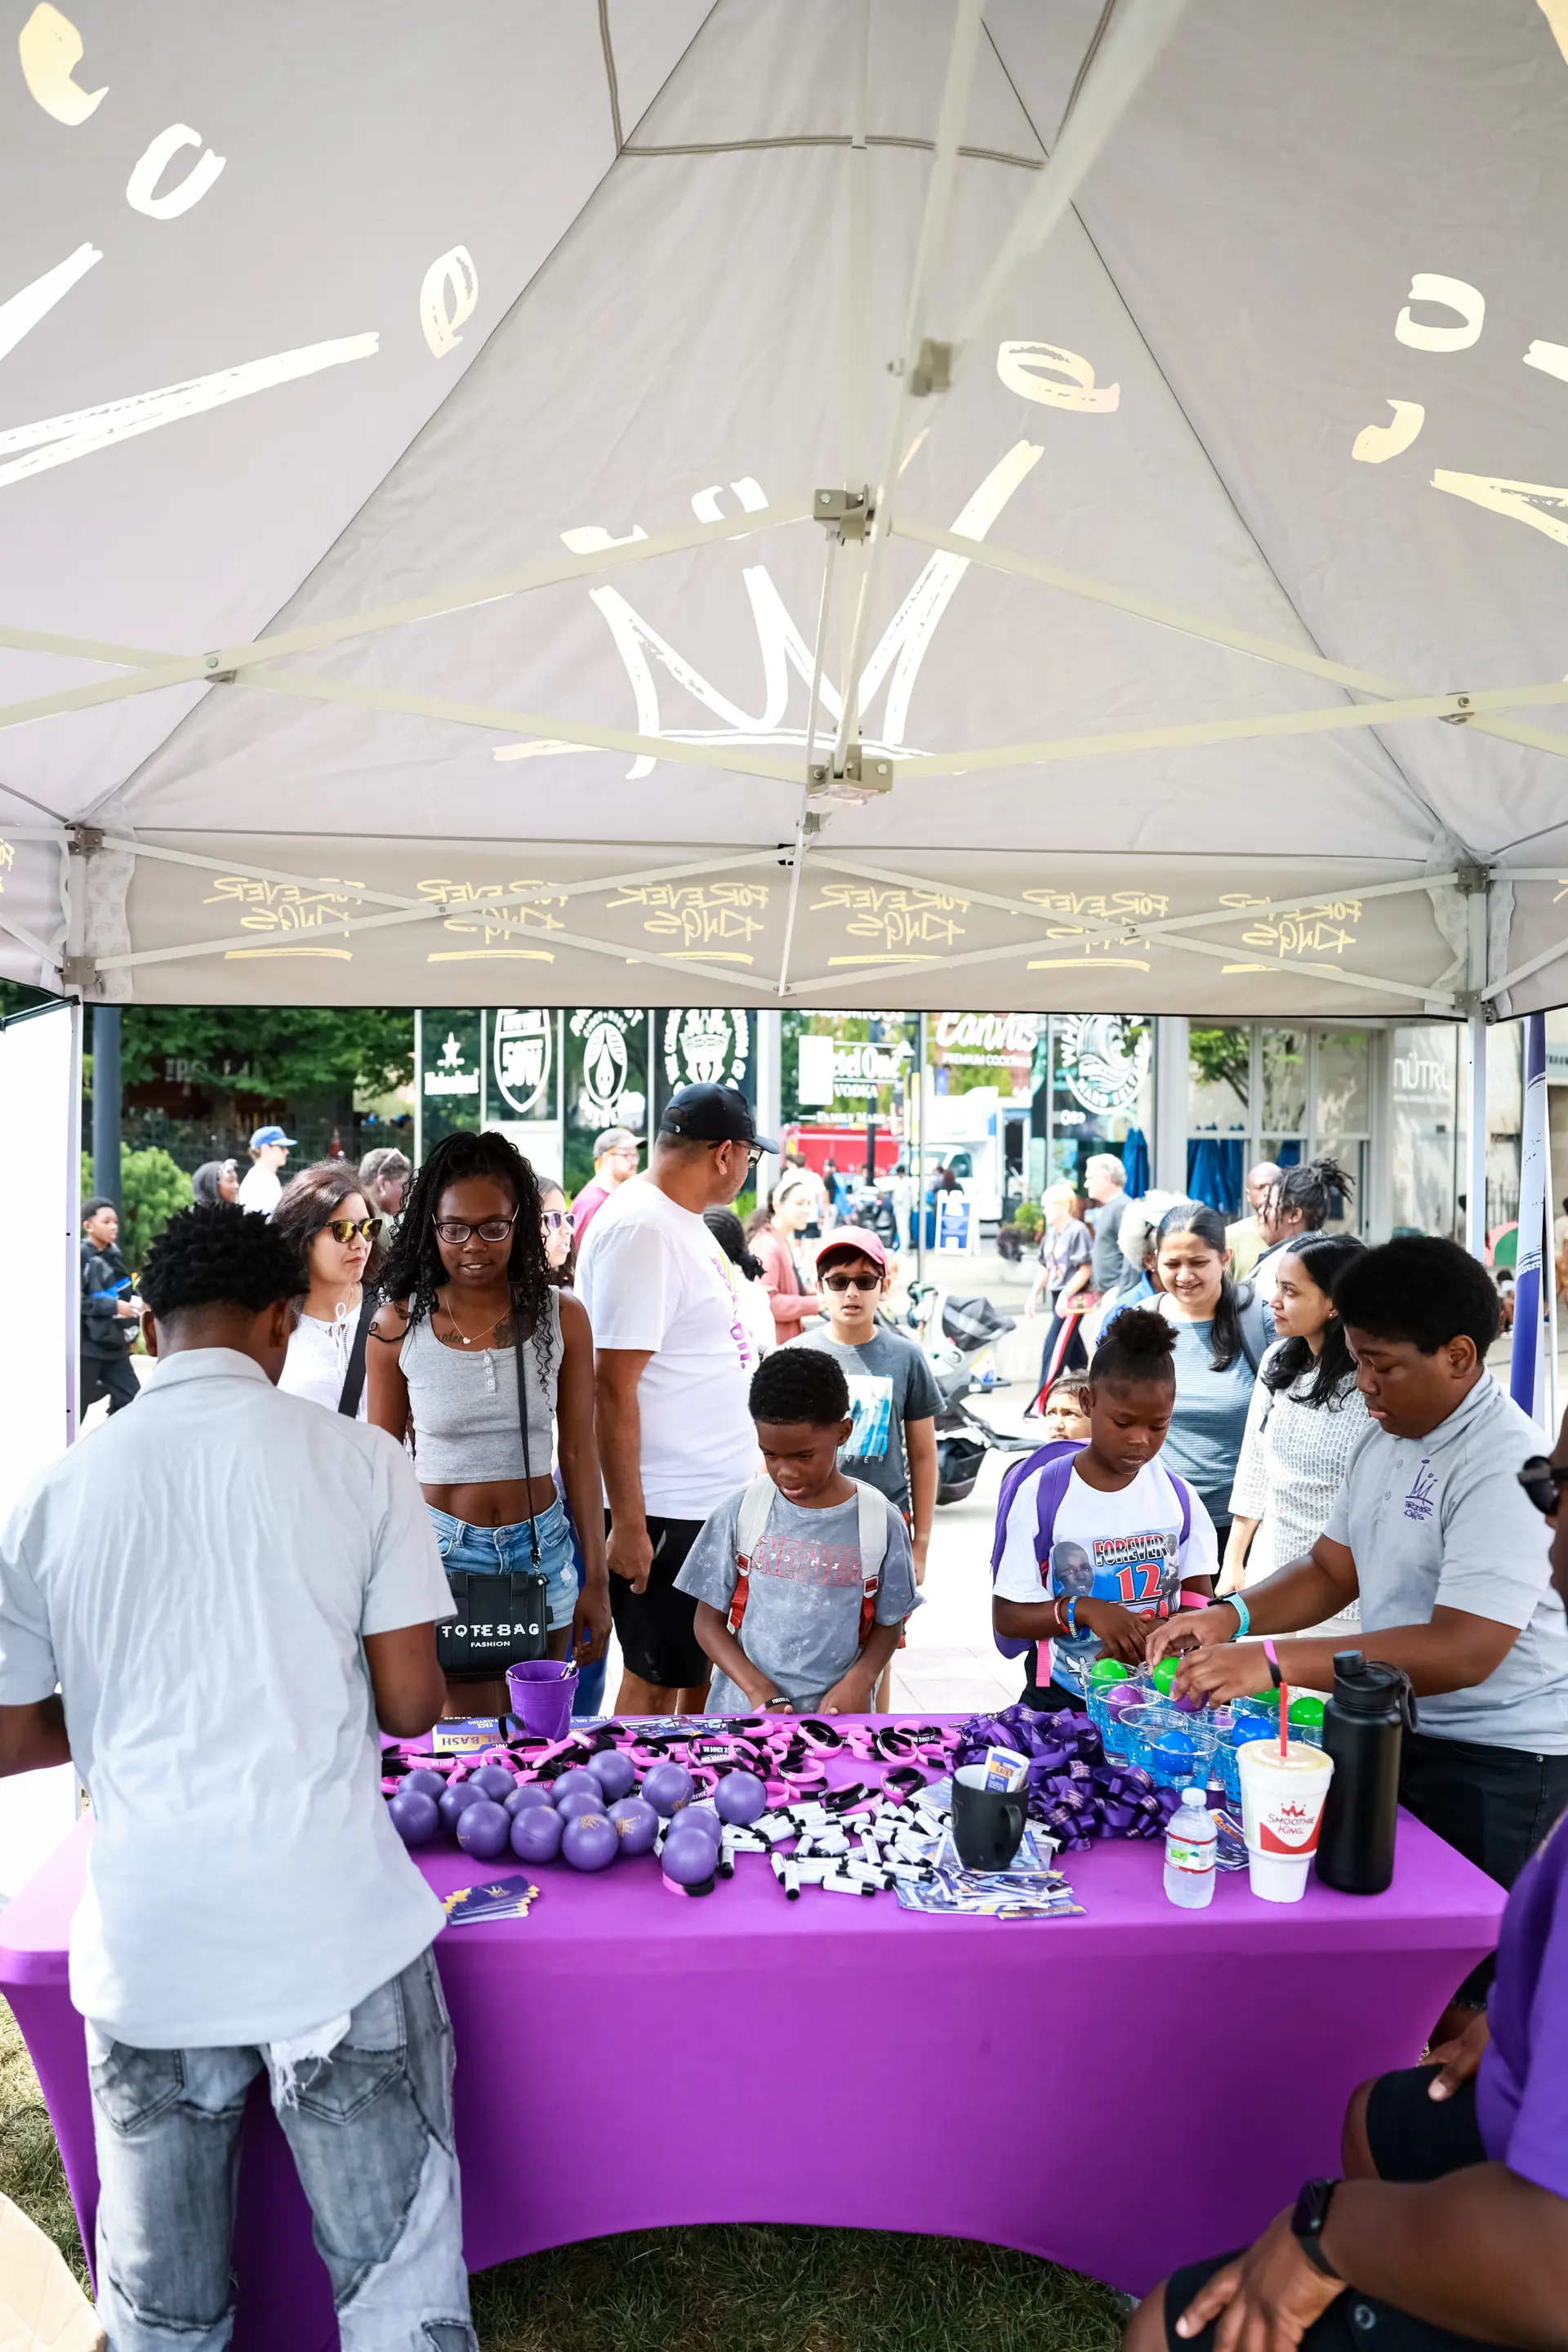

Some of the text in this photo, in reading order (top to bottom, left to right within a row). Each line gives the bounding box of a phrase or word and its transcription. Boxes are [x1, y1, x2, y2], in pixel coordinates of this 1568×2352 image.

[1093, 1533, 1169, 1566] FOREVER
[1116, 1563, 1163, 1601] 12
[441, 1623, 540, 1638] TOTE BAG
[442, 1736, 479, 1746] BASH
[1267, 1814, 1316, 1826] SMOOTHIE
